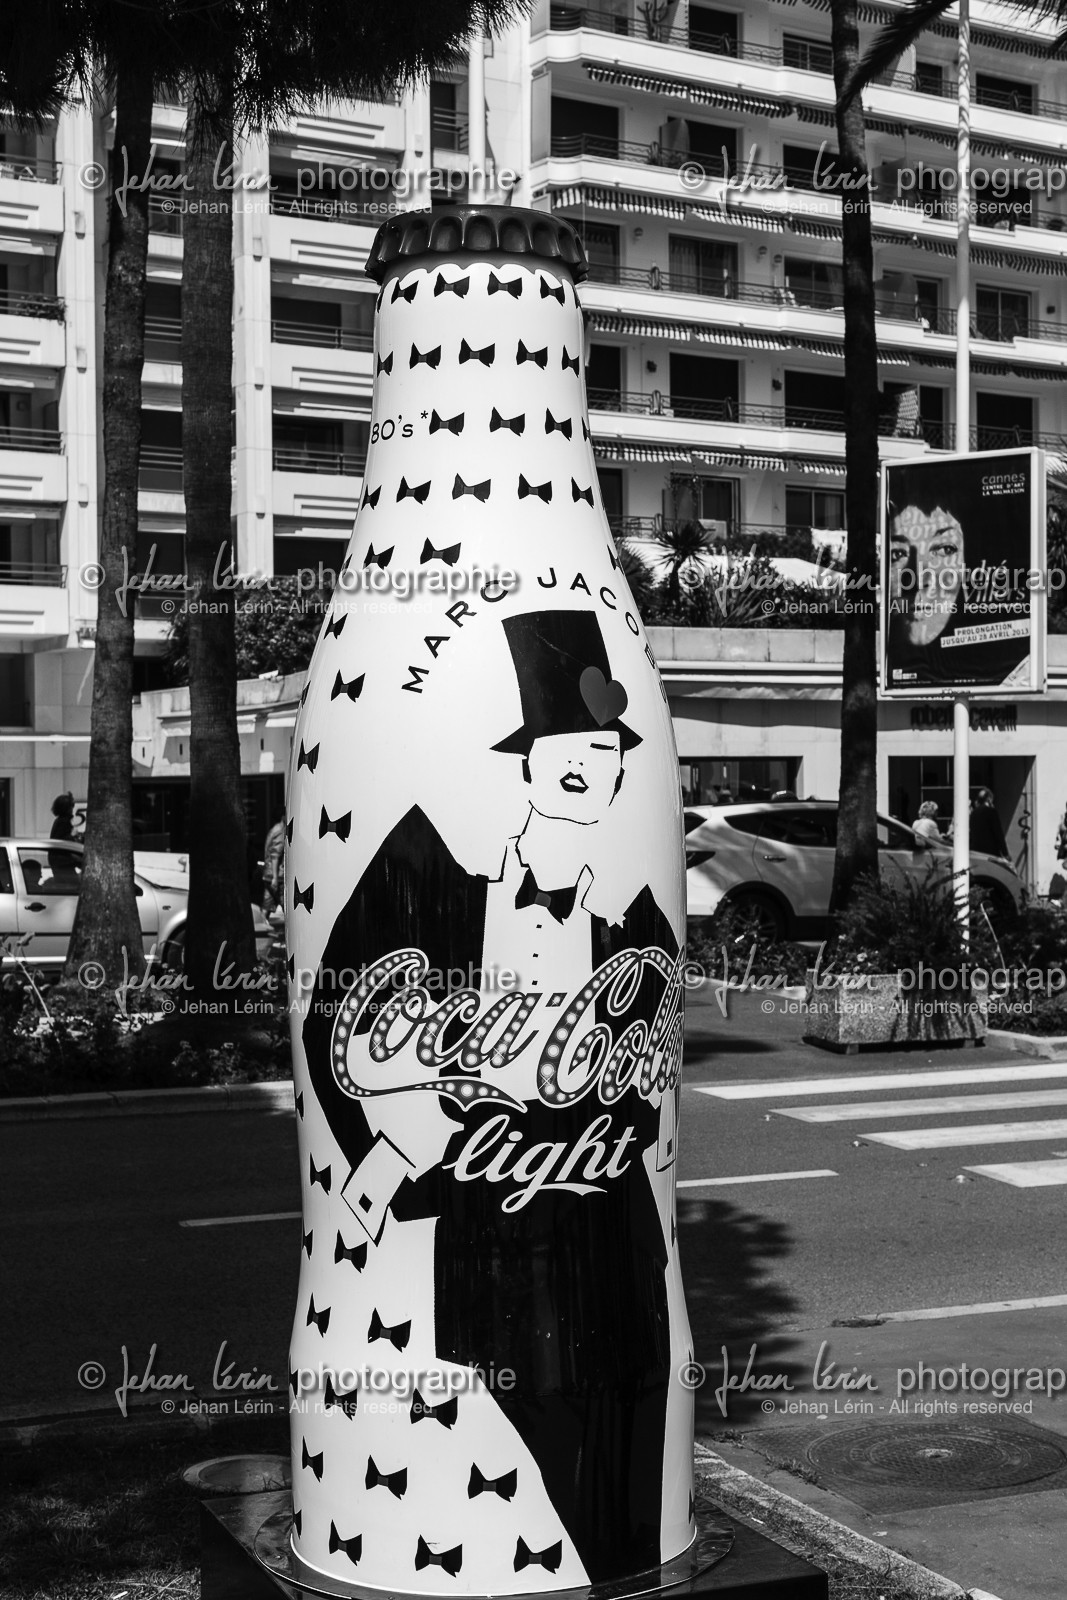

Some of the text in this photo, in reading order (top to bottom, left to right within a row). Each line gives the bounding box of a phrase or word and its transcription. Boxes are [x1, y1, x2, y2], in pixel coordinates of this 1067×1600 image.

[982, 473, 1025, 485] cannes
[401, 580, 508, 693] MARC
[942, 635, 977, 646] JUSQU'AU
[989, 631, 1010, 640] AVRIL
[1012, 628, 1029, 637] 2013
[957, 624, 1013, 636] PROLONGATION
[441, 1114, 637, 1213] light
